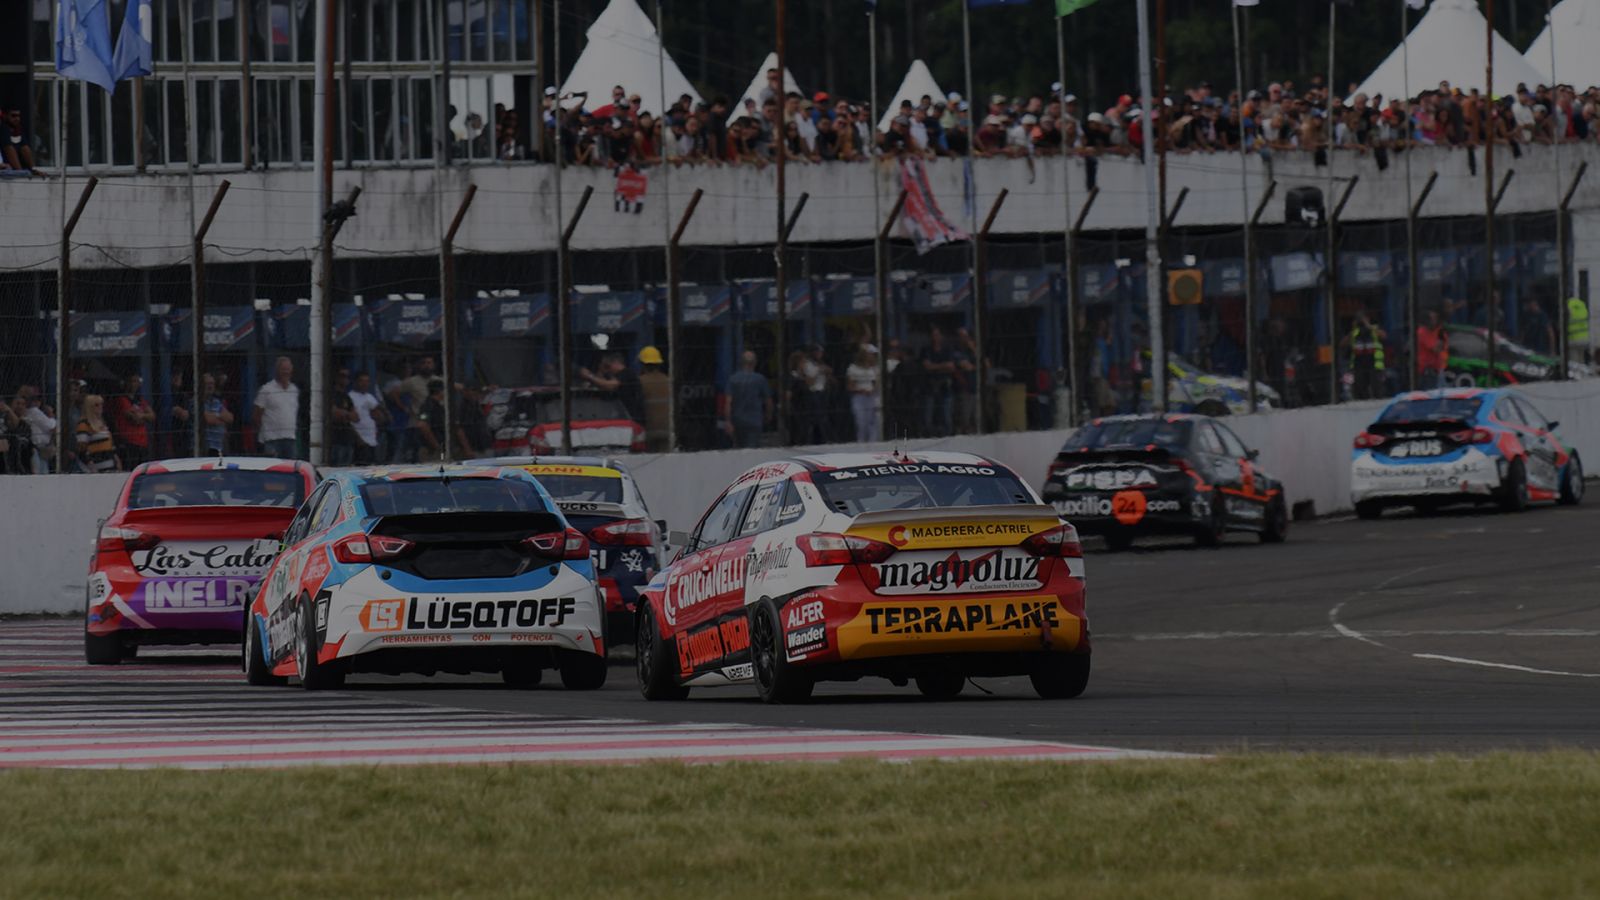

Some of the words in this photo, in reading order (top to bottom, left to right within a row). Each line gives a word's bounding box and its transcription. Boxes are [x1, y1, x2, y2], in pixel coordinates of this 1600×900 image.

[1409, 439, 1443, 456] RUS
[861, 465, 935, 478] TIENDA
[937, 465, 996, 477] AGRO
[1052, 496, 1112, 516] uxilio
[1117, 498, 1137, 513] 24
[912, 525, 983, 538] MADERERA
[985, 524, 1034, 535] CATRIEL
[136, 545, 195, 575] Las
[880, 549, 1042, 591] magnoluz
[677, 556, 744, 609] CRUCIANELLI
[407, 597, 575, 630] LÜSQTOFF
[787, 600, 825, 629] ALFER
[866, 602, 1059, 634] TERRAPLANE
[382, 634, 453, 643] HERRAMIENTAS
[788, 626, 825, 649] Wander
